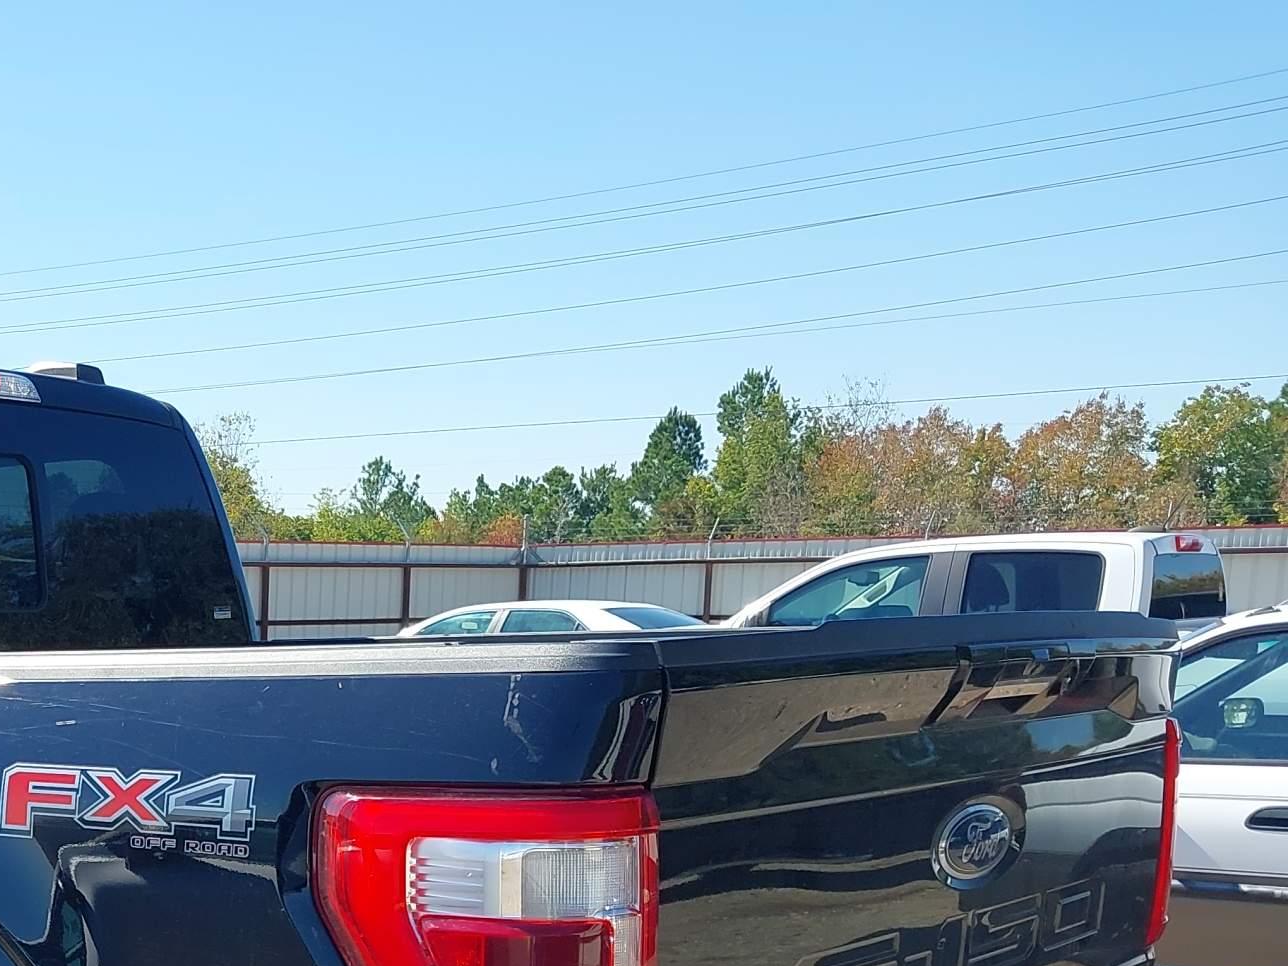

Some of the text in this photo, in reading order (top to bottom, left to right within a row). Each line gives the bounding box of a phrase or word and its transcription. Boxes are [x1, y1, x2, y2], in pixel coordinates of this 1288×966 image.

[130, 835, 250, 858] OFF ROAD
[962, 821, 1010, 864] Ford
